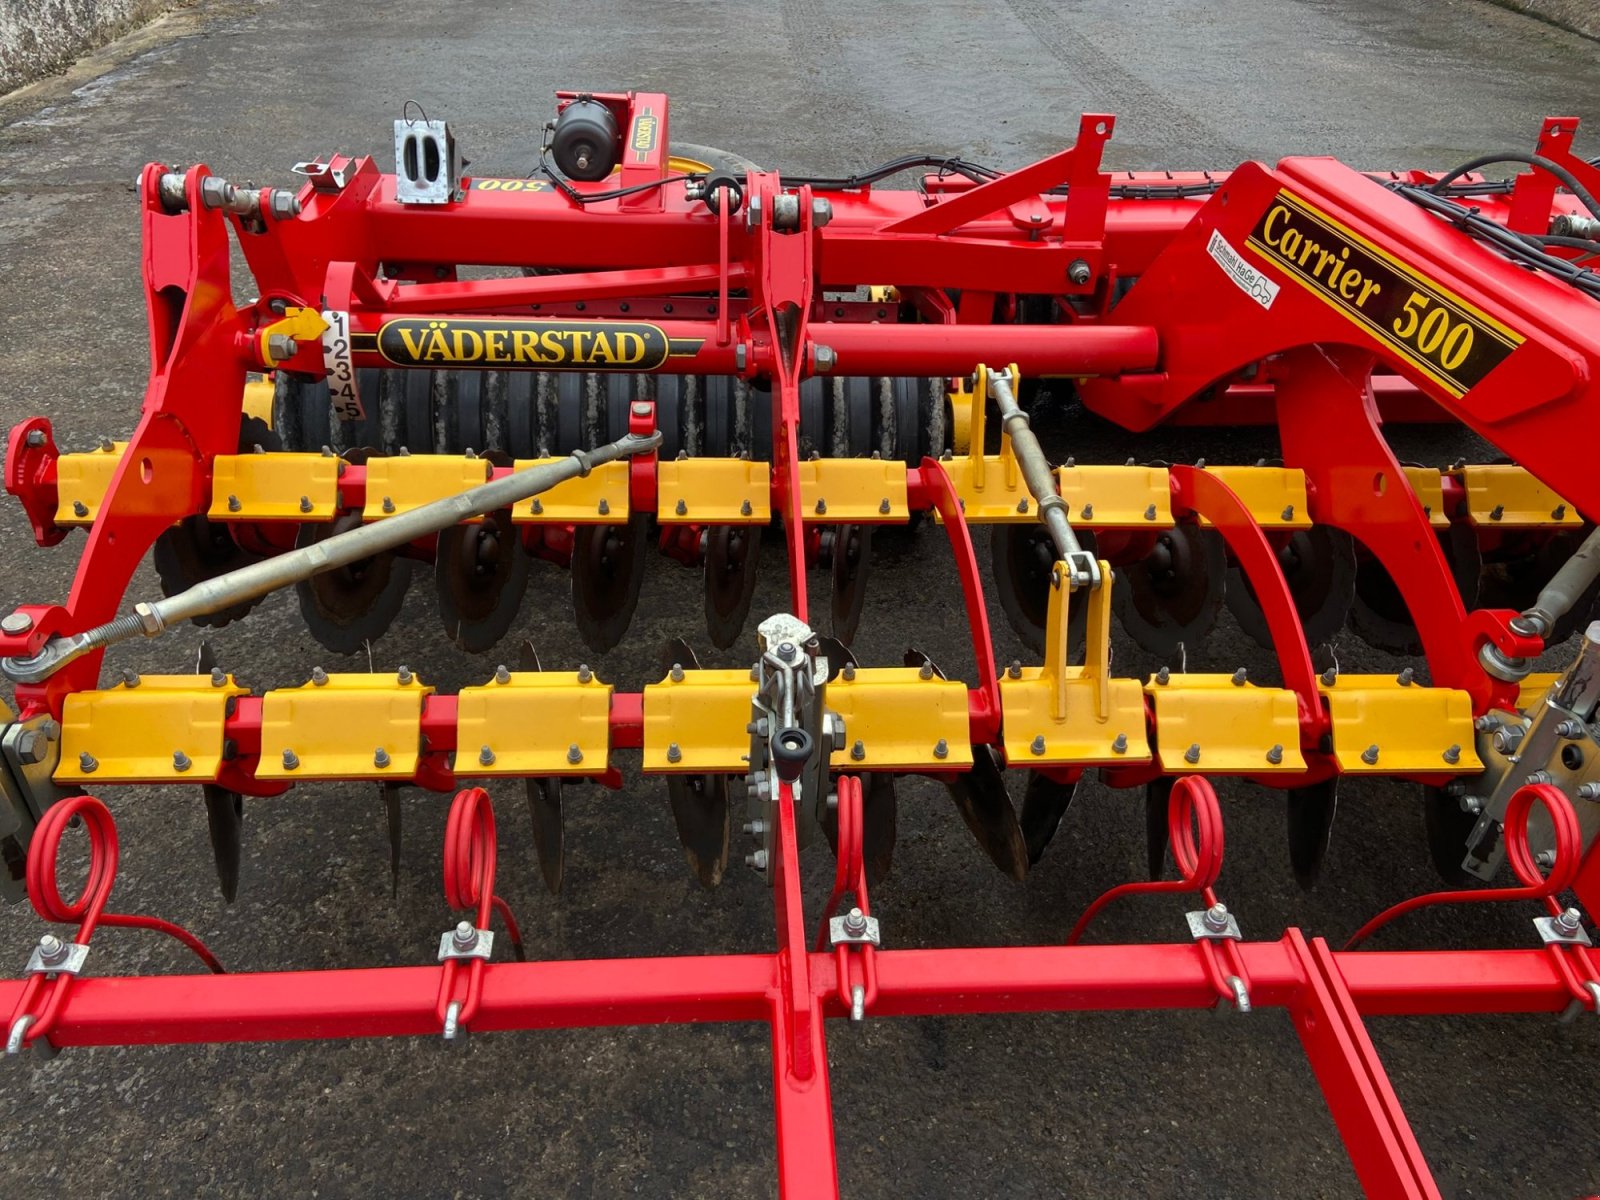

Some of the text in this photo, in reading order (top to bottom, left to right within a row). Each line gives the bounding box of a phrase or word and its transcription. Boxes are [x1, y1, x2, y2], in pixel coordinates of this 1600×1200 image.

[477, 180, 549, 192] 500
[1235, 261, 1256, 284] HaGe
[1262, 204, 1381, 308] Carrier
[1393, 290, 1475, 370] 500
[334, 316, 344, 337] 1
[333, 339, 349, 360] 2
[335, 361, 352, 382] 3
[340, 383, 356, 401] 4
[344, 402, 361, 417] 5
